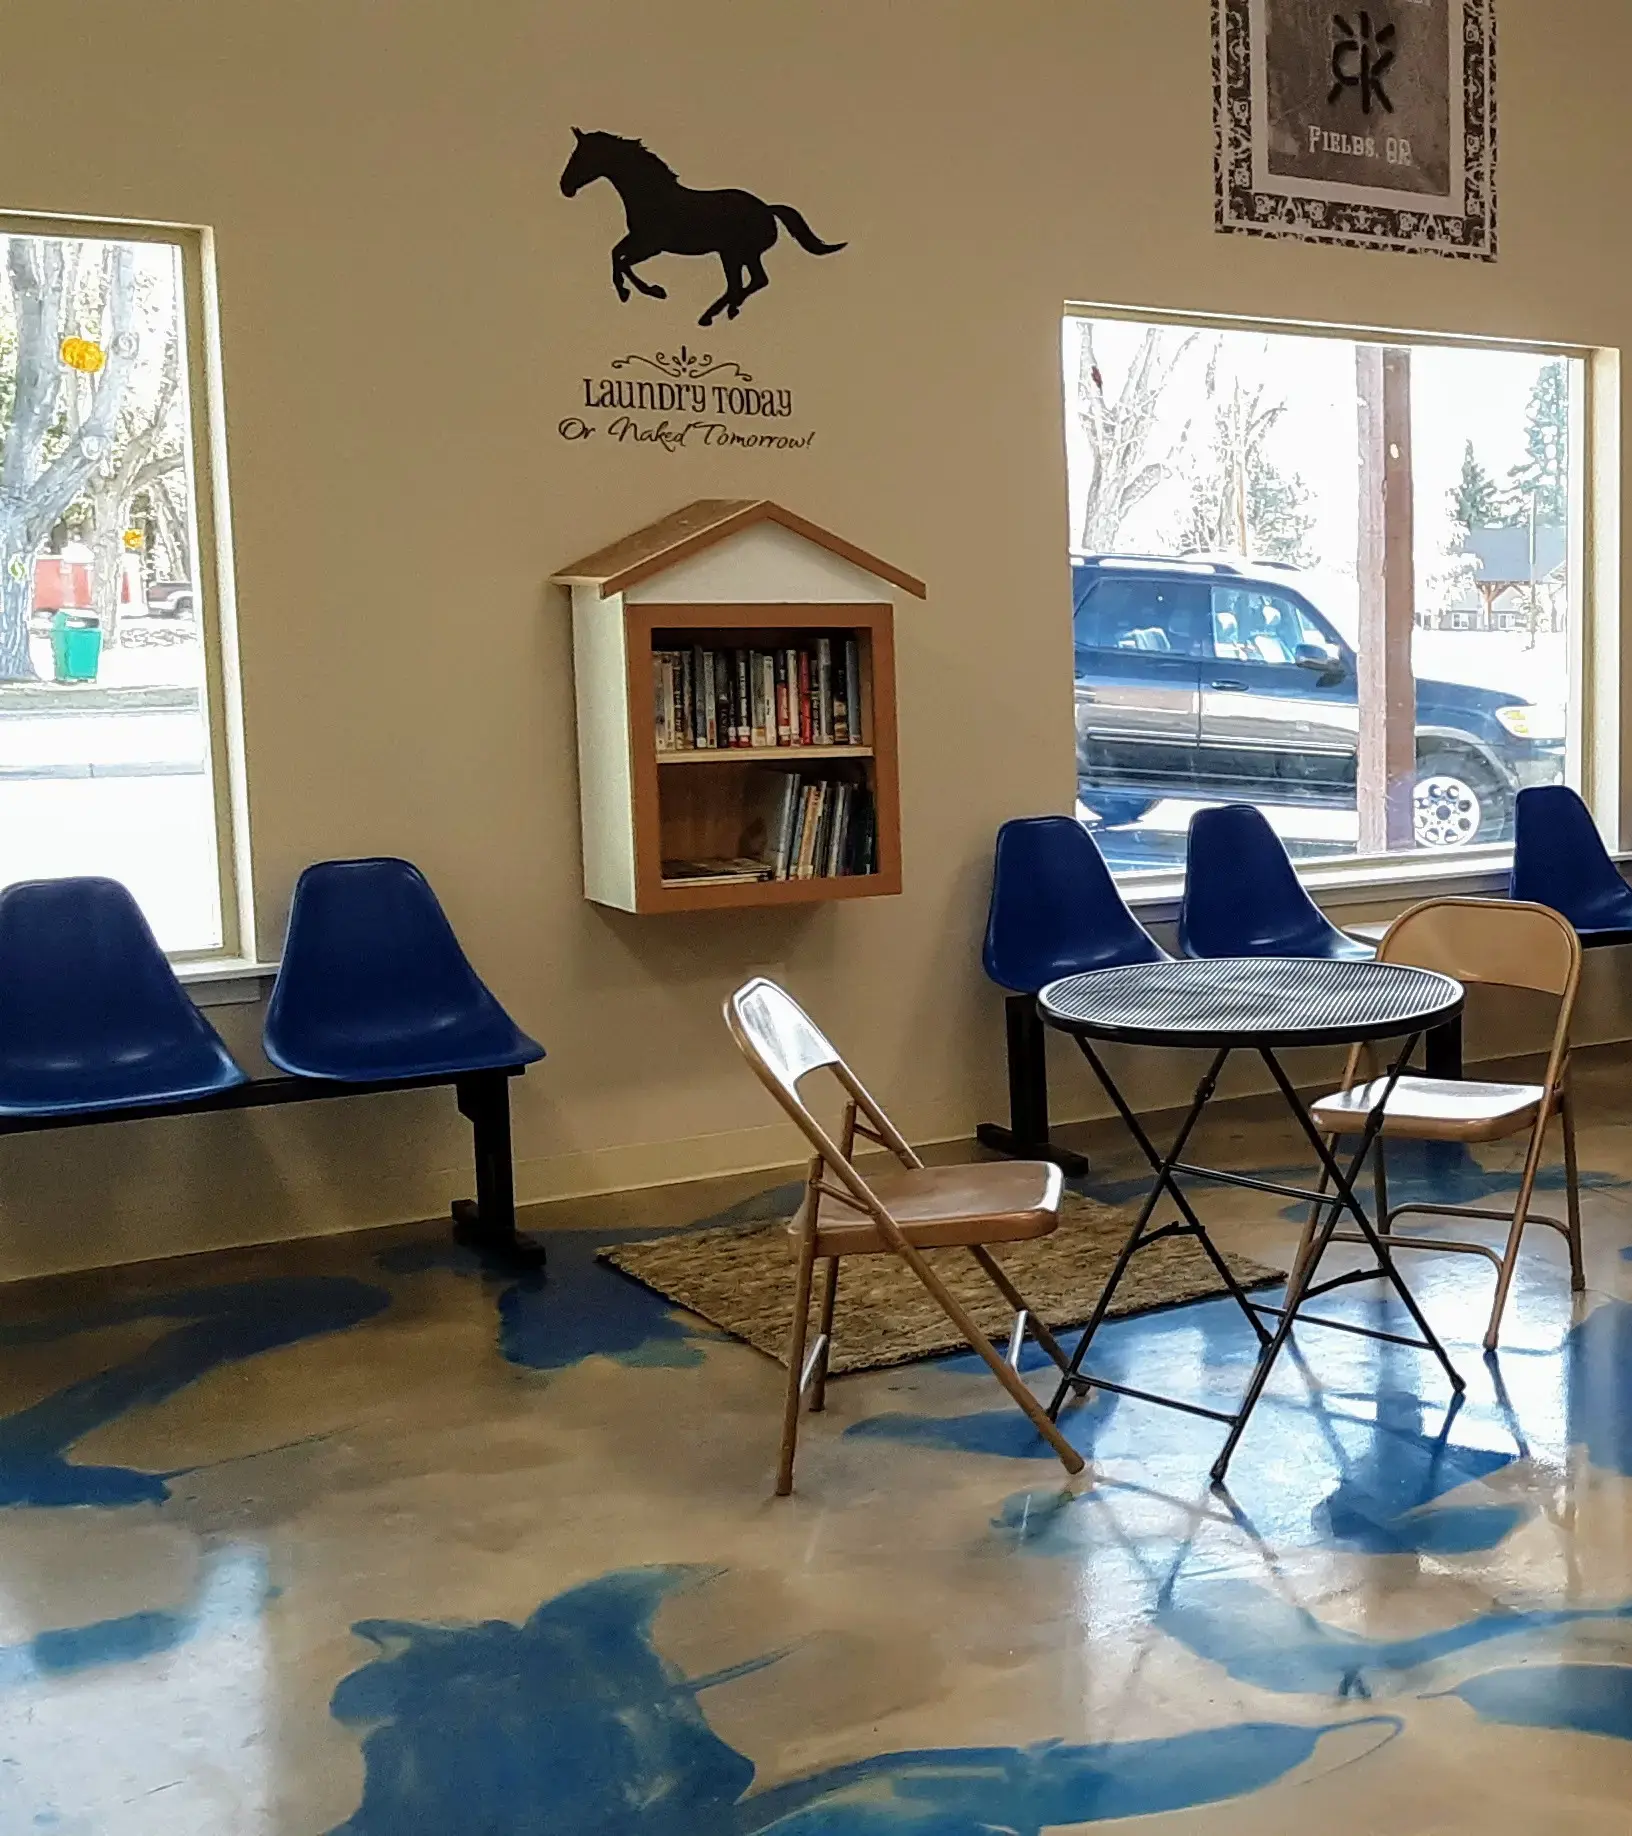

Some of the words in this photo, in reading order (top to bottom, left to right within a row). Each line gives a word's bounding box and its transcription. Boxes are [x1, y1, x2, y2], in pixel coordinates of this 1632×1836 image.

[558, 417, 596, 440] Or
[608, 416, 692, 452] Naked
[692, 421, 815, 450] Tomorrow!
